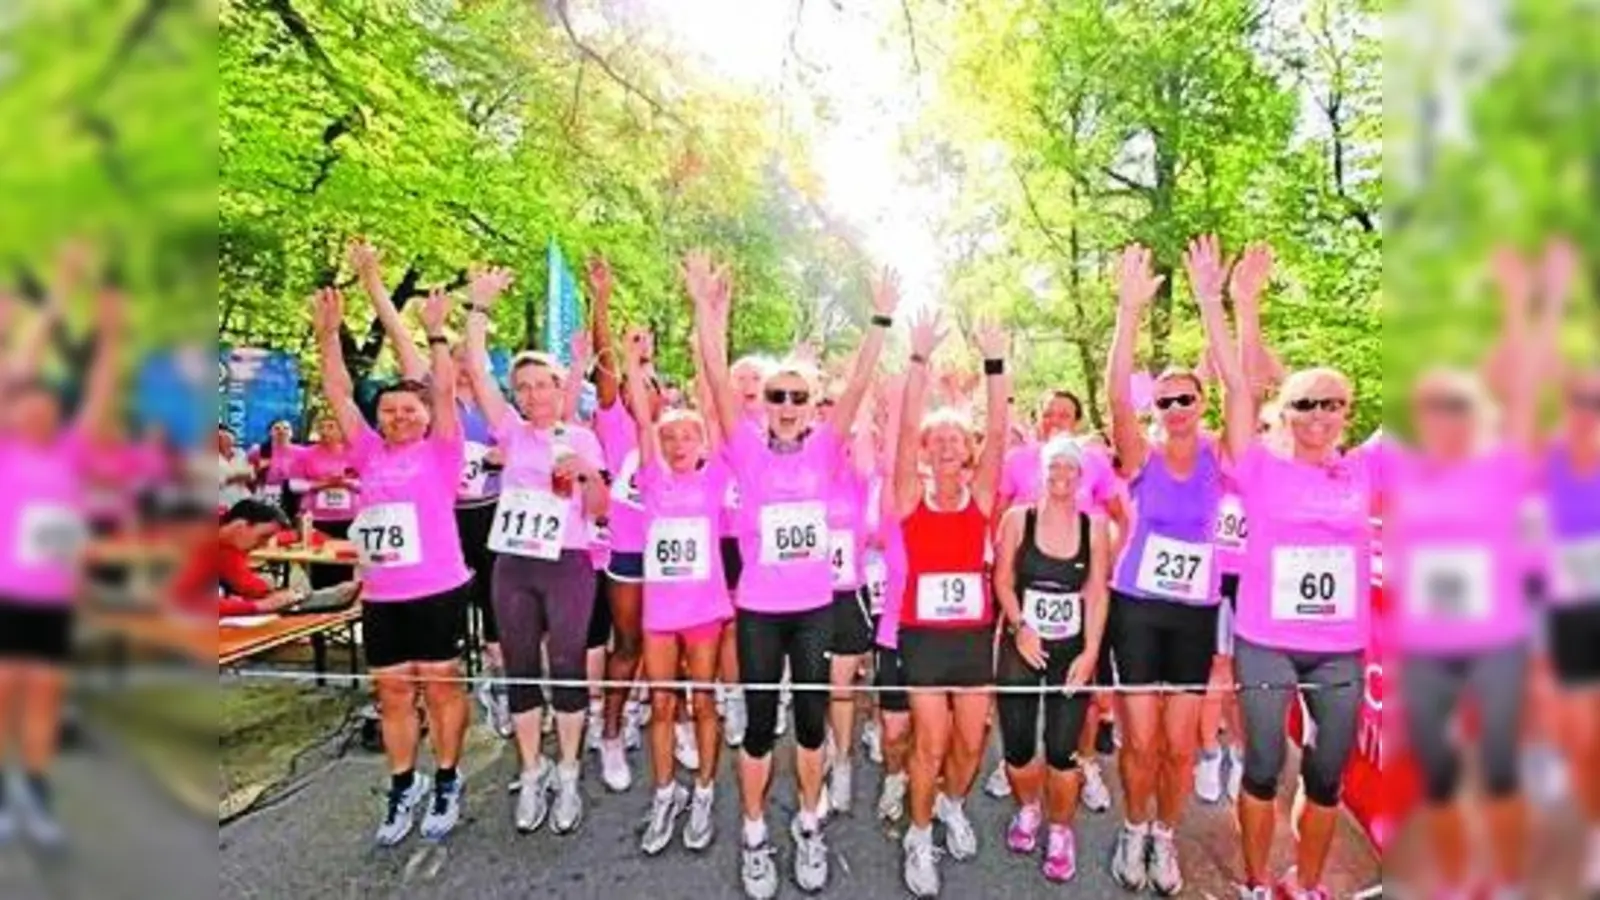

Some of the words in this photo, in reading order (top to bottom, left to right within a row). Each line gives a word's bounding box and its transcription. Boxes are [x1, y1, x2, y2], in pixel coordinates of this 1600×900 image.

[359, 525, 404, 551] 778
[501, 510, 560, 541] 1112
[775, 524, 816, 550] 606
[656, 537, 697, 563] 698
[1154, 551, 1201, 581] 237
[939, 577, 966, 603] 19
[1300, 572, 1336, 600] 60
[1035, 597, 1073, 623] 620
